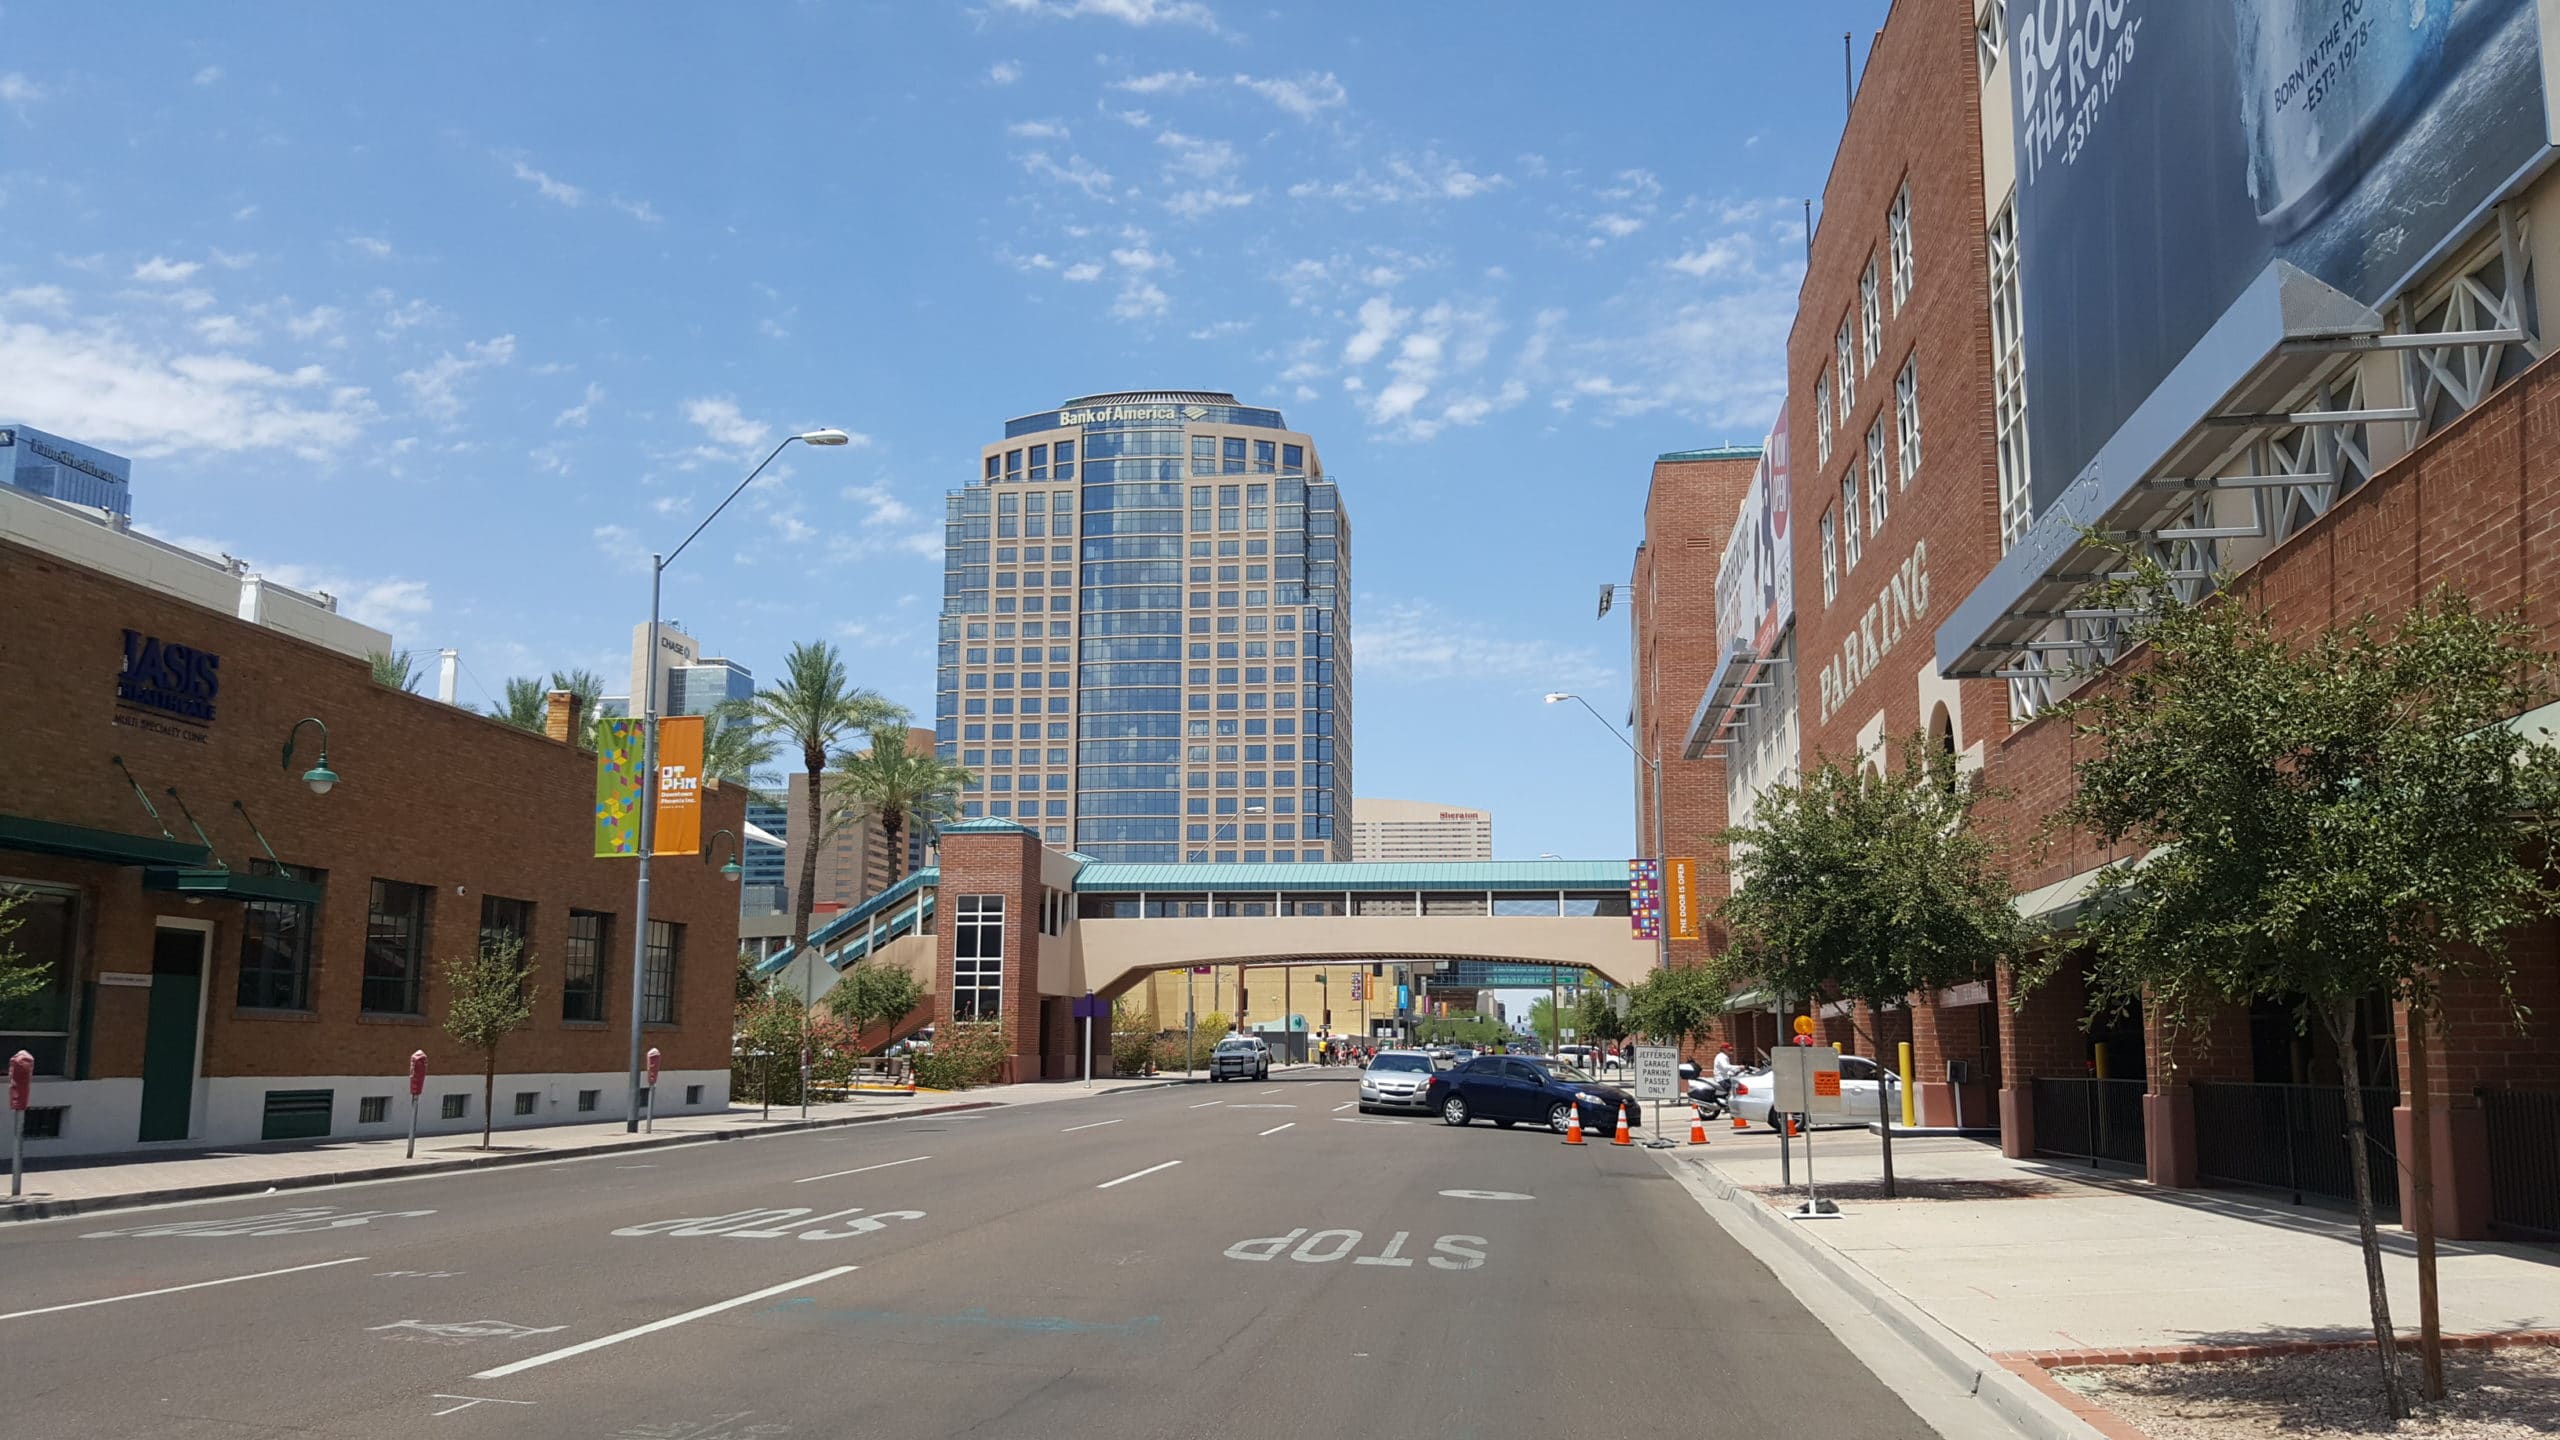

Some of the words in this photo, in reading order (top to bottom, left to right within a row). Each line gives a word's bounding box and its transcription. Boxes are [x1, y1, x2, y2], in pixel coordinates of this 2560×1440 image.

[2020, 0, 2076, 122] BO
[2275, 63, 2304, 113] BORN
[2306, 50, 2319, 78] IN
[2319, 21, 2340, 62] THE
[2025, 65, 2064, 186] THE
[1060, 411, 1096, 426] Bank
[1097, 407, 1112, 422] of
[1113, 405, 1175, 421] America
[1820, 537, 1930, 727] PARKING
[661, 637, 684, 655] CHASE
[1439, 811, 1479, 819] Sheraton
[1677, 863, 1685, 885] OPEN
[1642, 1069, 1672, 1077] PARKING
[1644, 1078, 1670, 1086] PASSES
[1223, 1228, 1489, 1270] STOP
